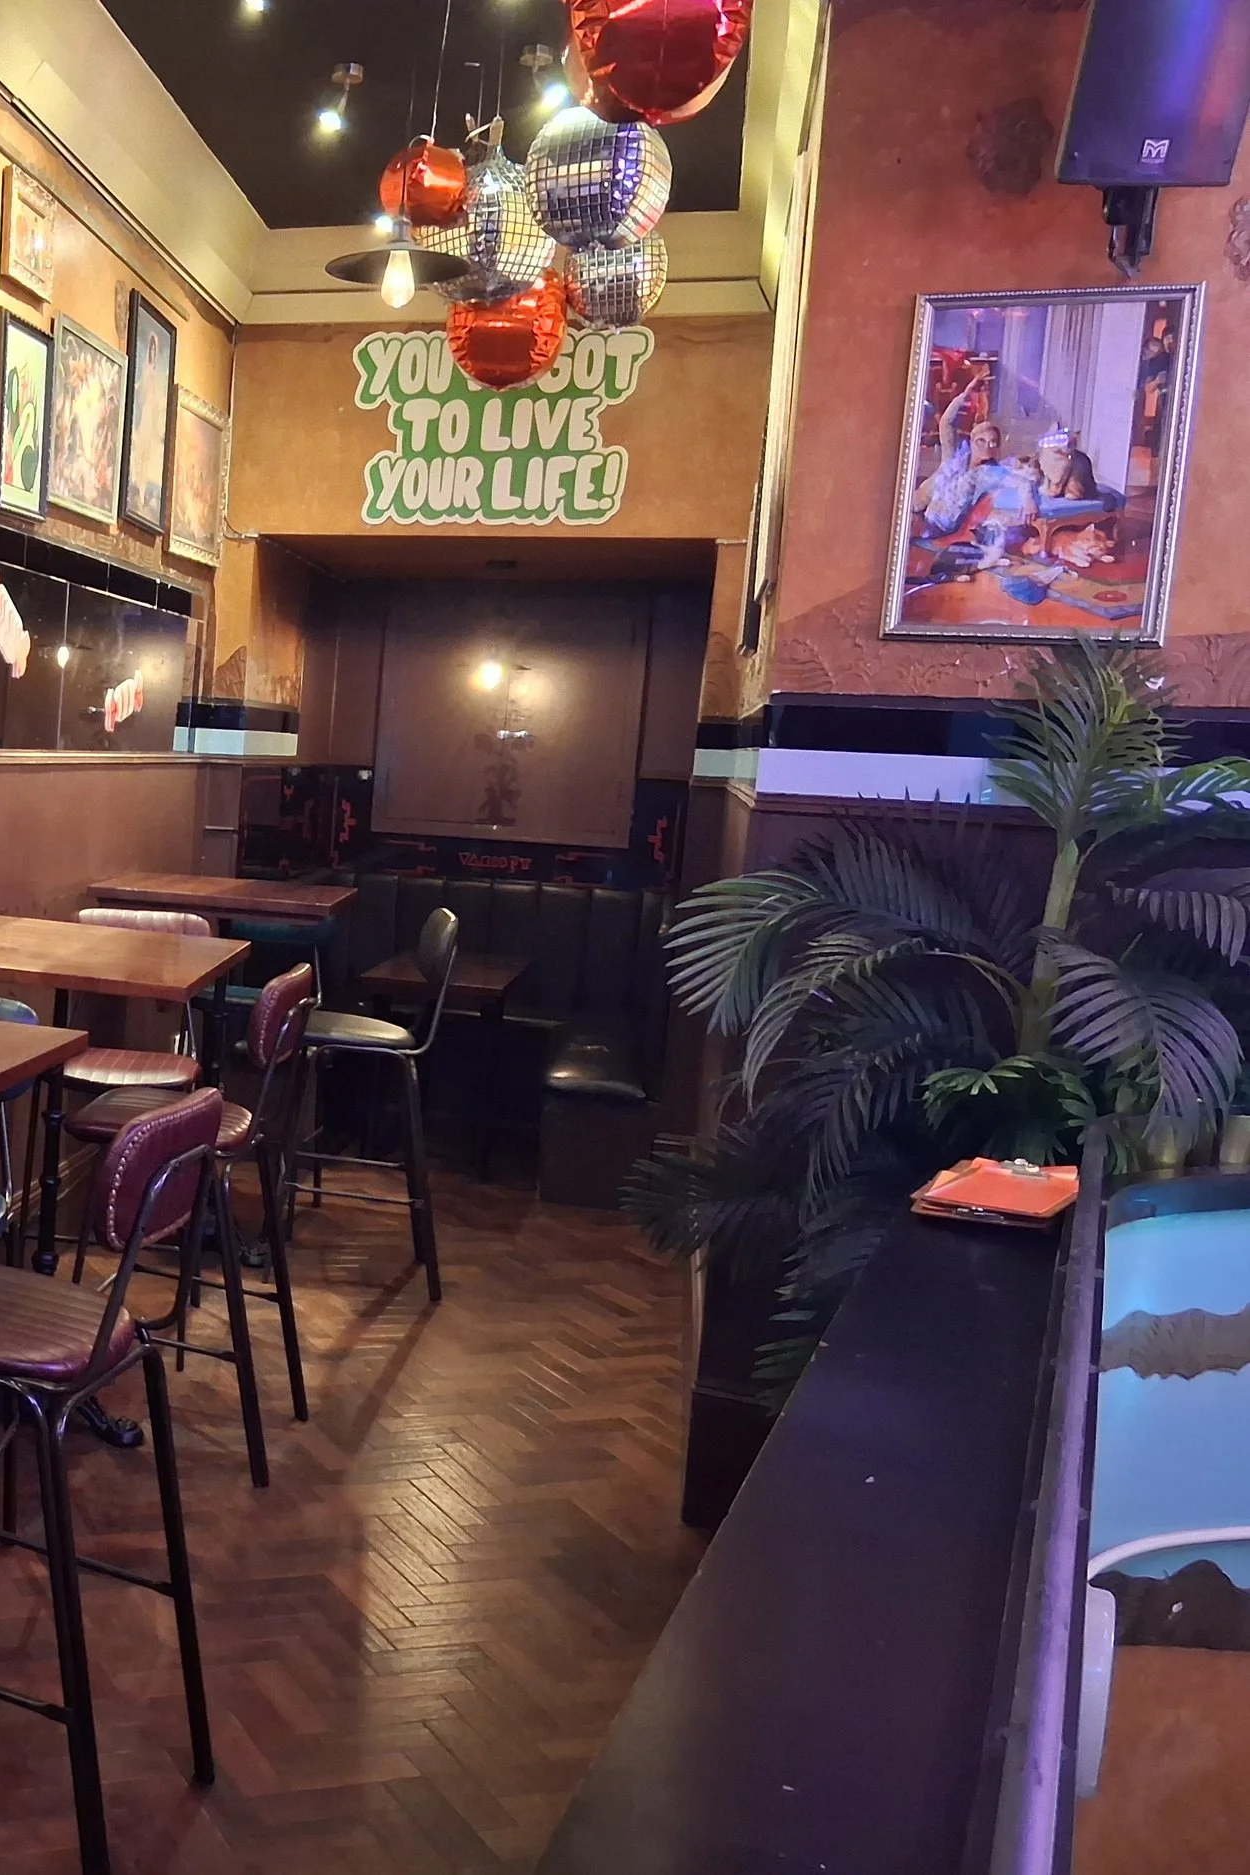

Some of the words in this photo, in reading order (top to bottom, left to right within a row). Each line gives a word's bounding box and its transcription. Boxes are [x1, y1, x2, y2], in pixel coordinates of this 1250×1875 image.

[402, 398, 470, 453] TO
[480, 397, 602, 451] LIVE
[375, 456, 484, 512] YOUR
[491, 453, 620, 512] LIFE!
